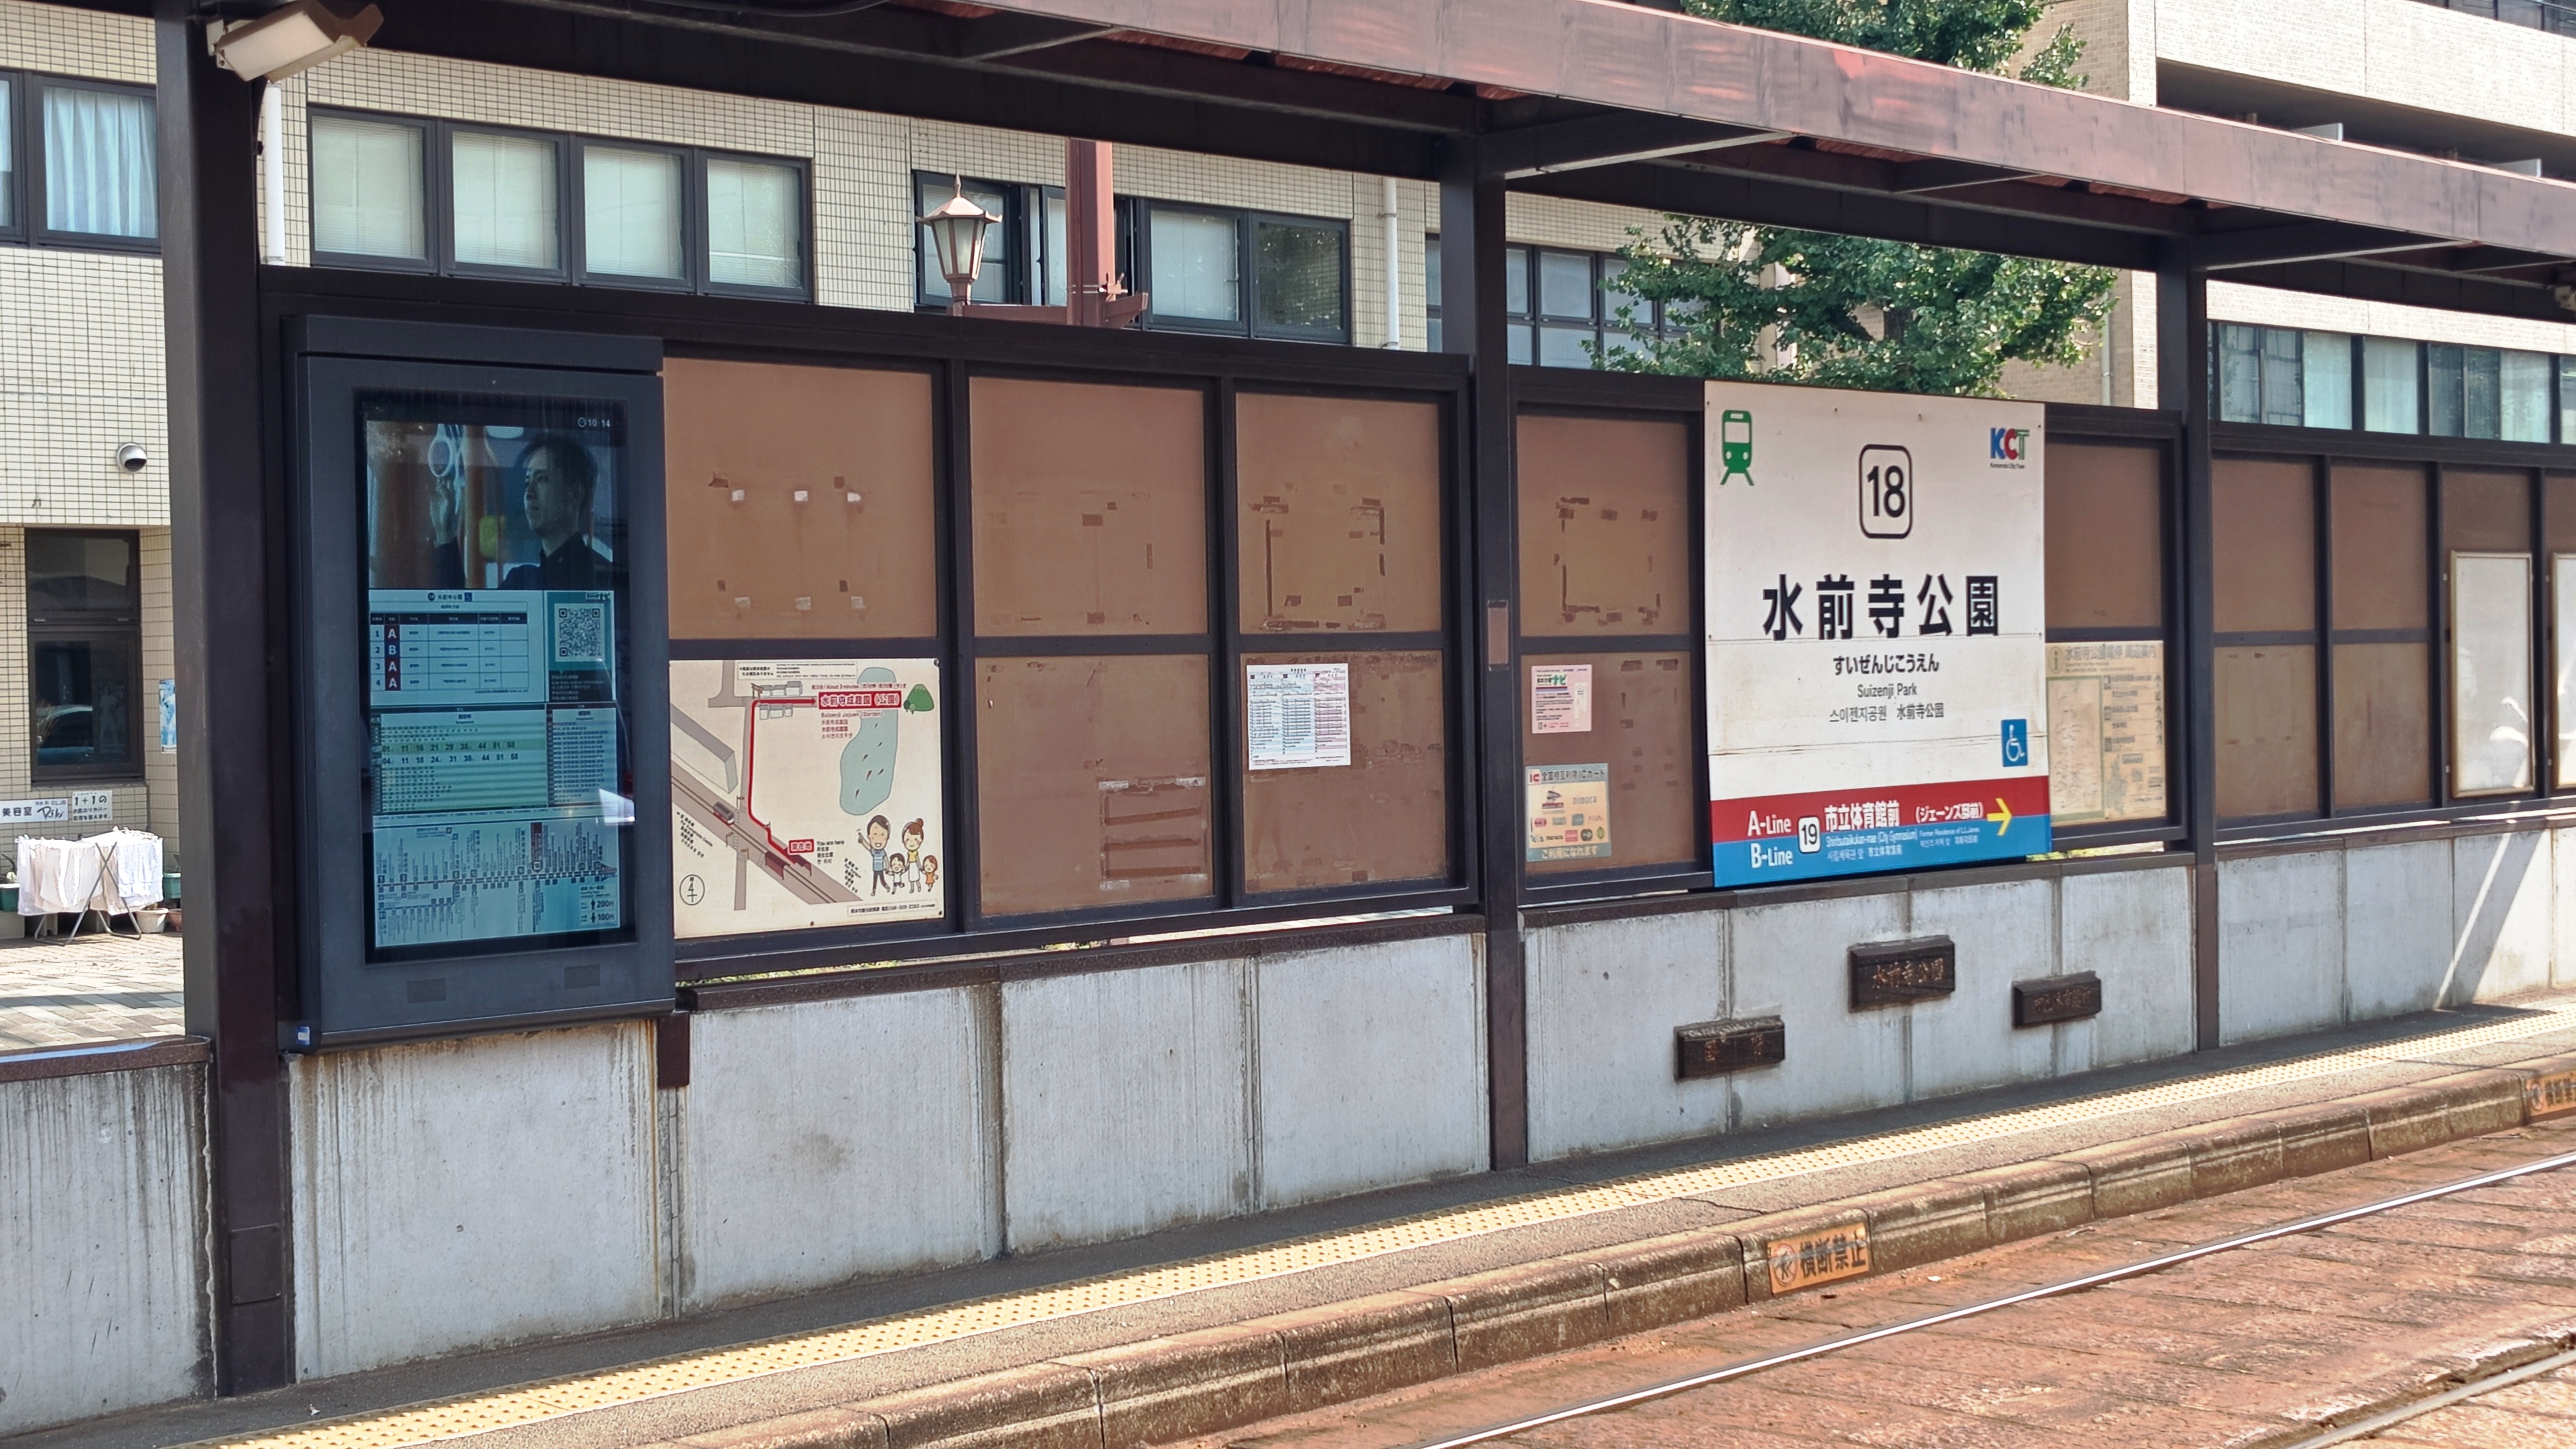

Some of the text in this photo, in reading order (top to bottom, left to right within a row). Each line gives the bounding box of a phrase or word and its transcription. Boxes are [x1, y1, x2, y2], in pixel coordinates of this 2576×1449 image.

[1990, 428, 2029, 460] KCT
[1867, 465, 1906, 518] 18
[1762, 574, 1999, 641] 水前寺公園
[388, 629, 397, 639] A
[389, 645, 396, 655] B
[389, 662, 397, 672] A
[1833, 653, 1940, 676] すいぜんじこうえん
[389, 678, 397, 688] A
[1857, 683, 1918, 699] Suizenji Park
[1829, 705, 1887, 723] 스이젠지공원
[1747, 810, 1792, 836] A-Line
[1824, 799, 1900, 833] 市立体育館前
[1801, 823, 1818, 845] 19
[1750, 842, 1794, 869] B-Line
